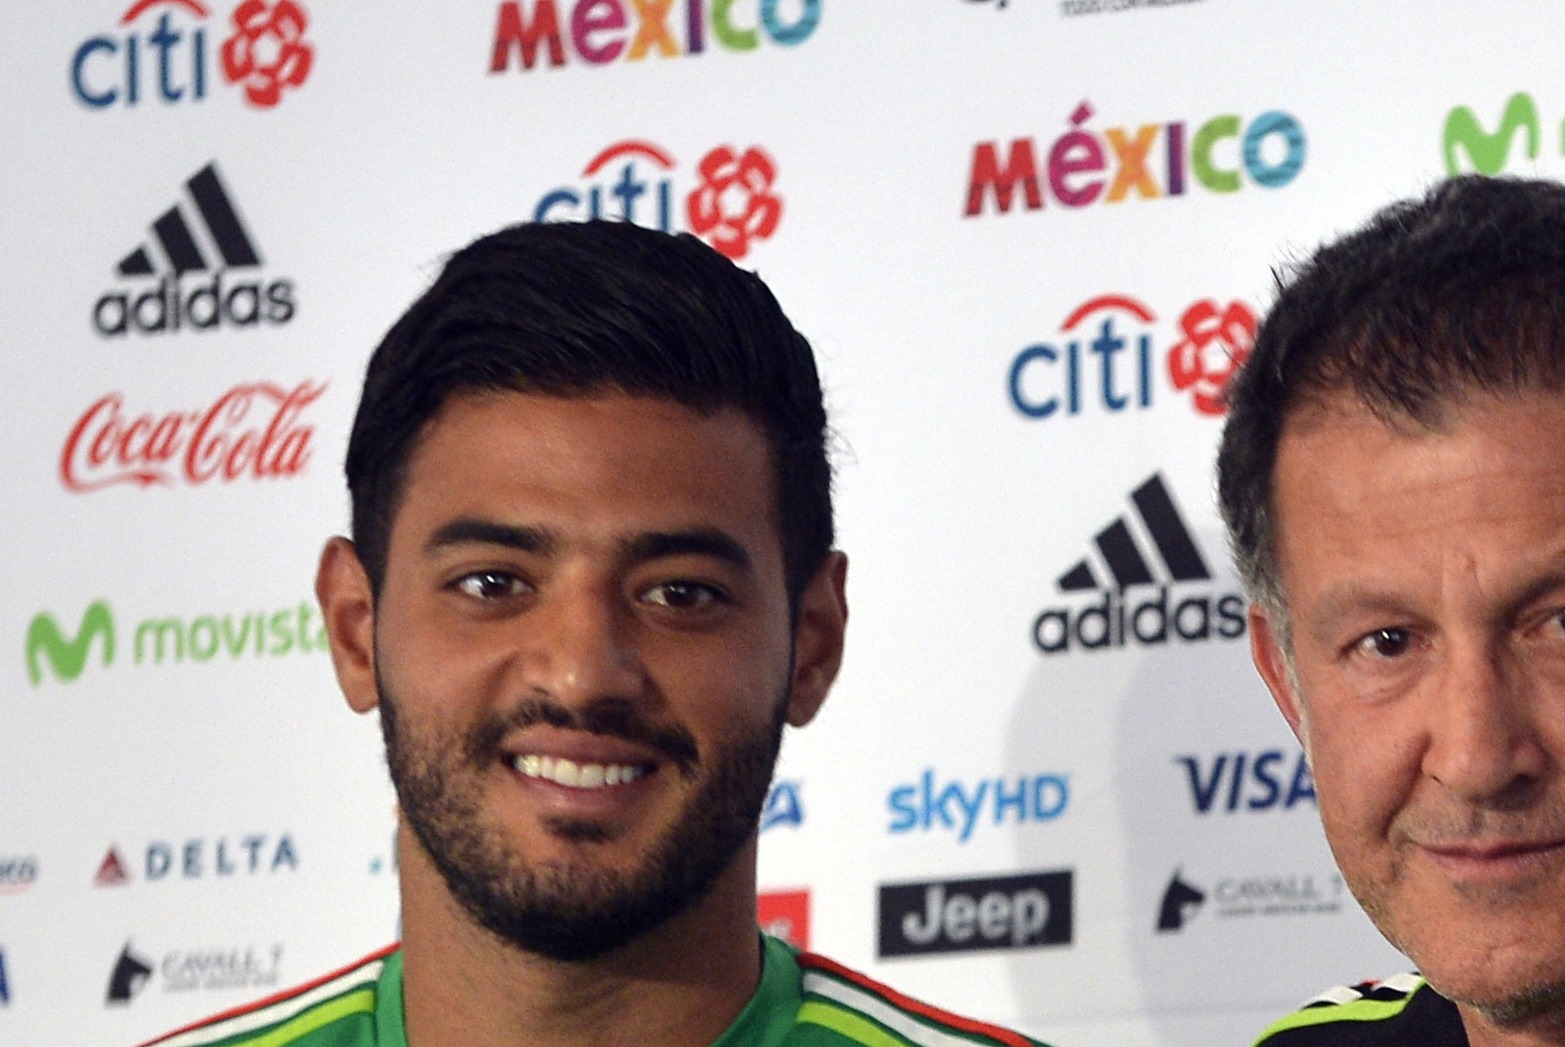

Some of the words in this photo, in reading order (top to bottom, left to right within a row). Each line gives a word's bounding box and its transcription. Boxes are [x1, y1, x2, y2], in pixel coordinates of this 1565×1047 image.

[92, 268, 298, 339] adidas
[1007, 314, 1153, 421] citi
[60, 379, 329, 494] Coca-Cola
[134, 601, 332, 666] movist
[1031, 586, 1247, 655] adidas
[144, 832, 298, 881] DELTA
[903, 883, 1050, 944] Jeep
